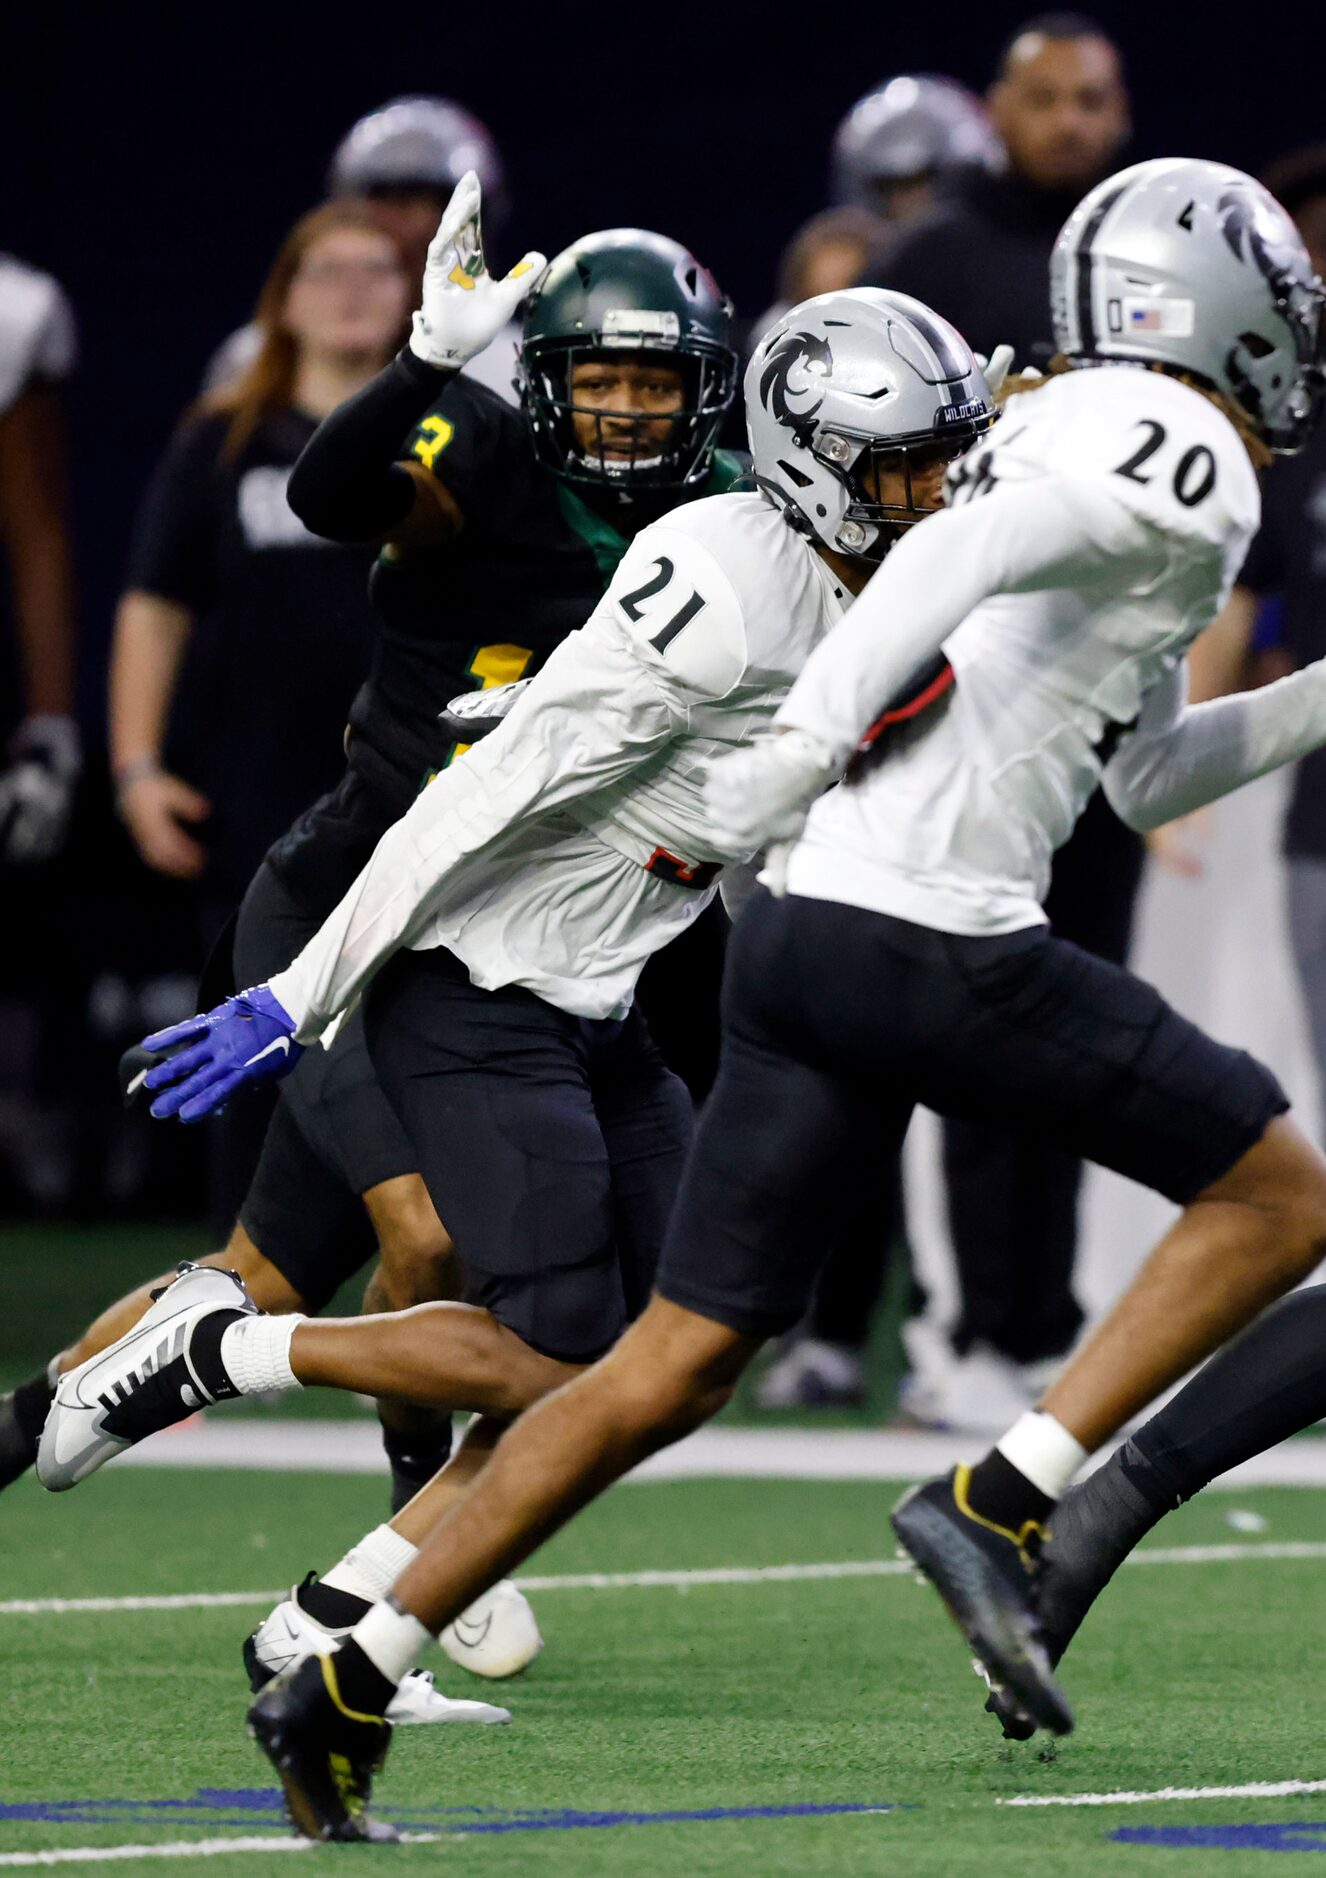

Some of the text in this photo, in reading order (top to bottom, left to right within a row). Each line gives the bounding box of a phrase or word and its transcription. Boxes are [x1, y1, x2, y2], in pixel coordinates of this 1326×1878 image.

[943, 402, 985, 423] WILDCATS
[1110, 418, 1218, 508] 20
[617, 554, 709, 659] 21
